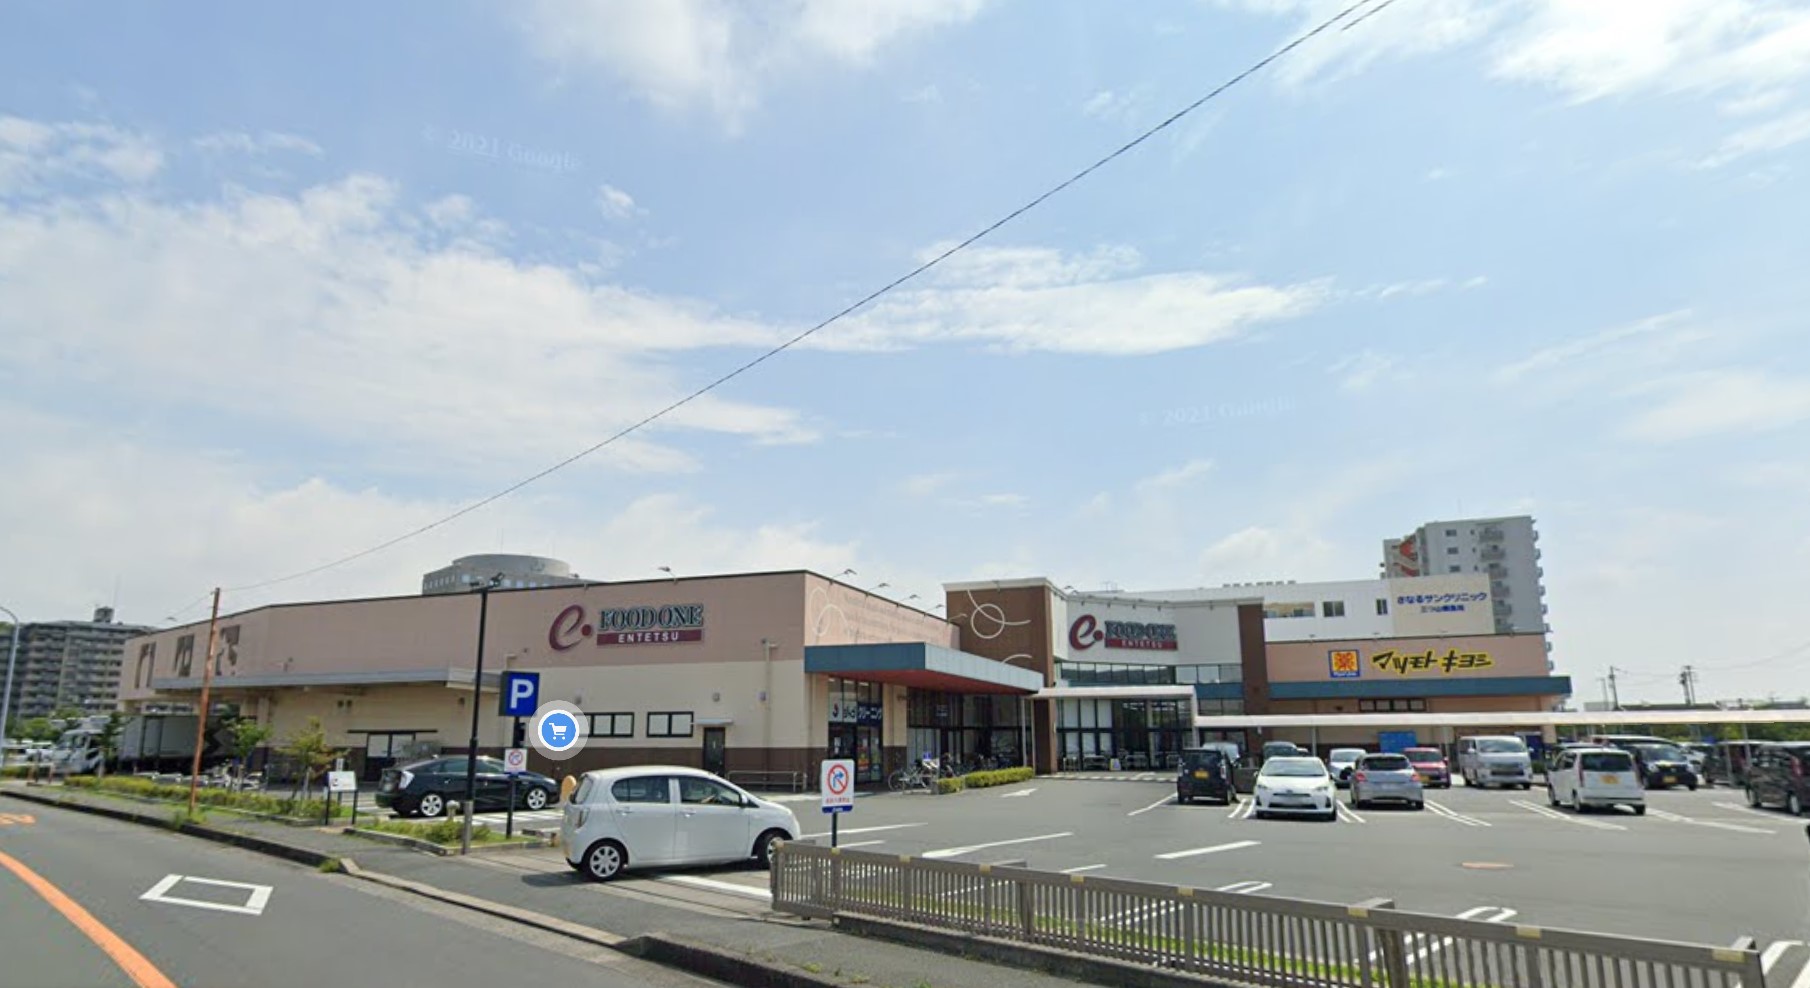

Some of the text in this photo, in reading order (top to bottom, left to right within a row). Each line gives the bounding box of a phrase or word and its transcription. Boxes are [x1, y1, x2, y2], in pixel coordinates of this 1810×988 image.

[599, 602, 705, 631] FOOD ONE
[617, 632, 680, 644] ENTETSU
[510, 678, 534, 709] P
